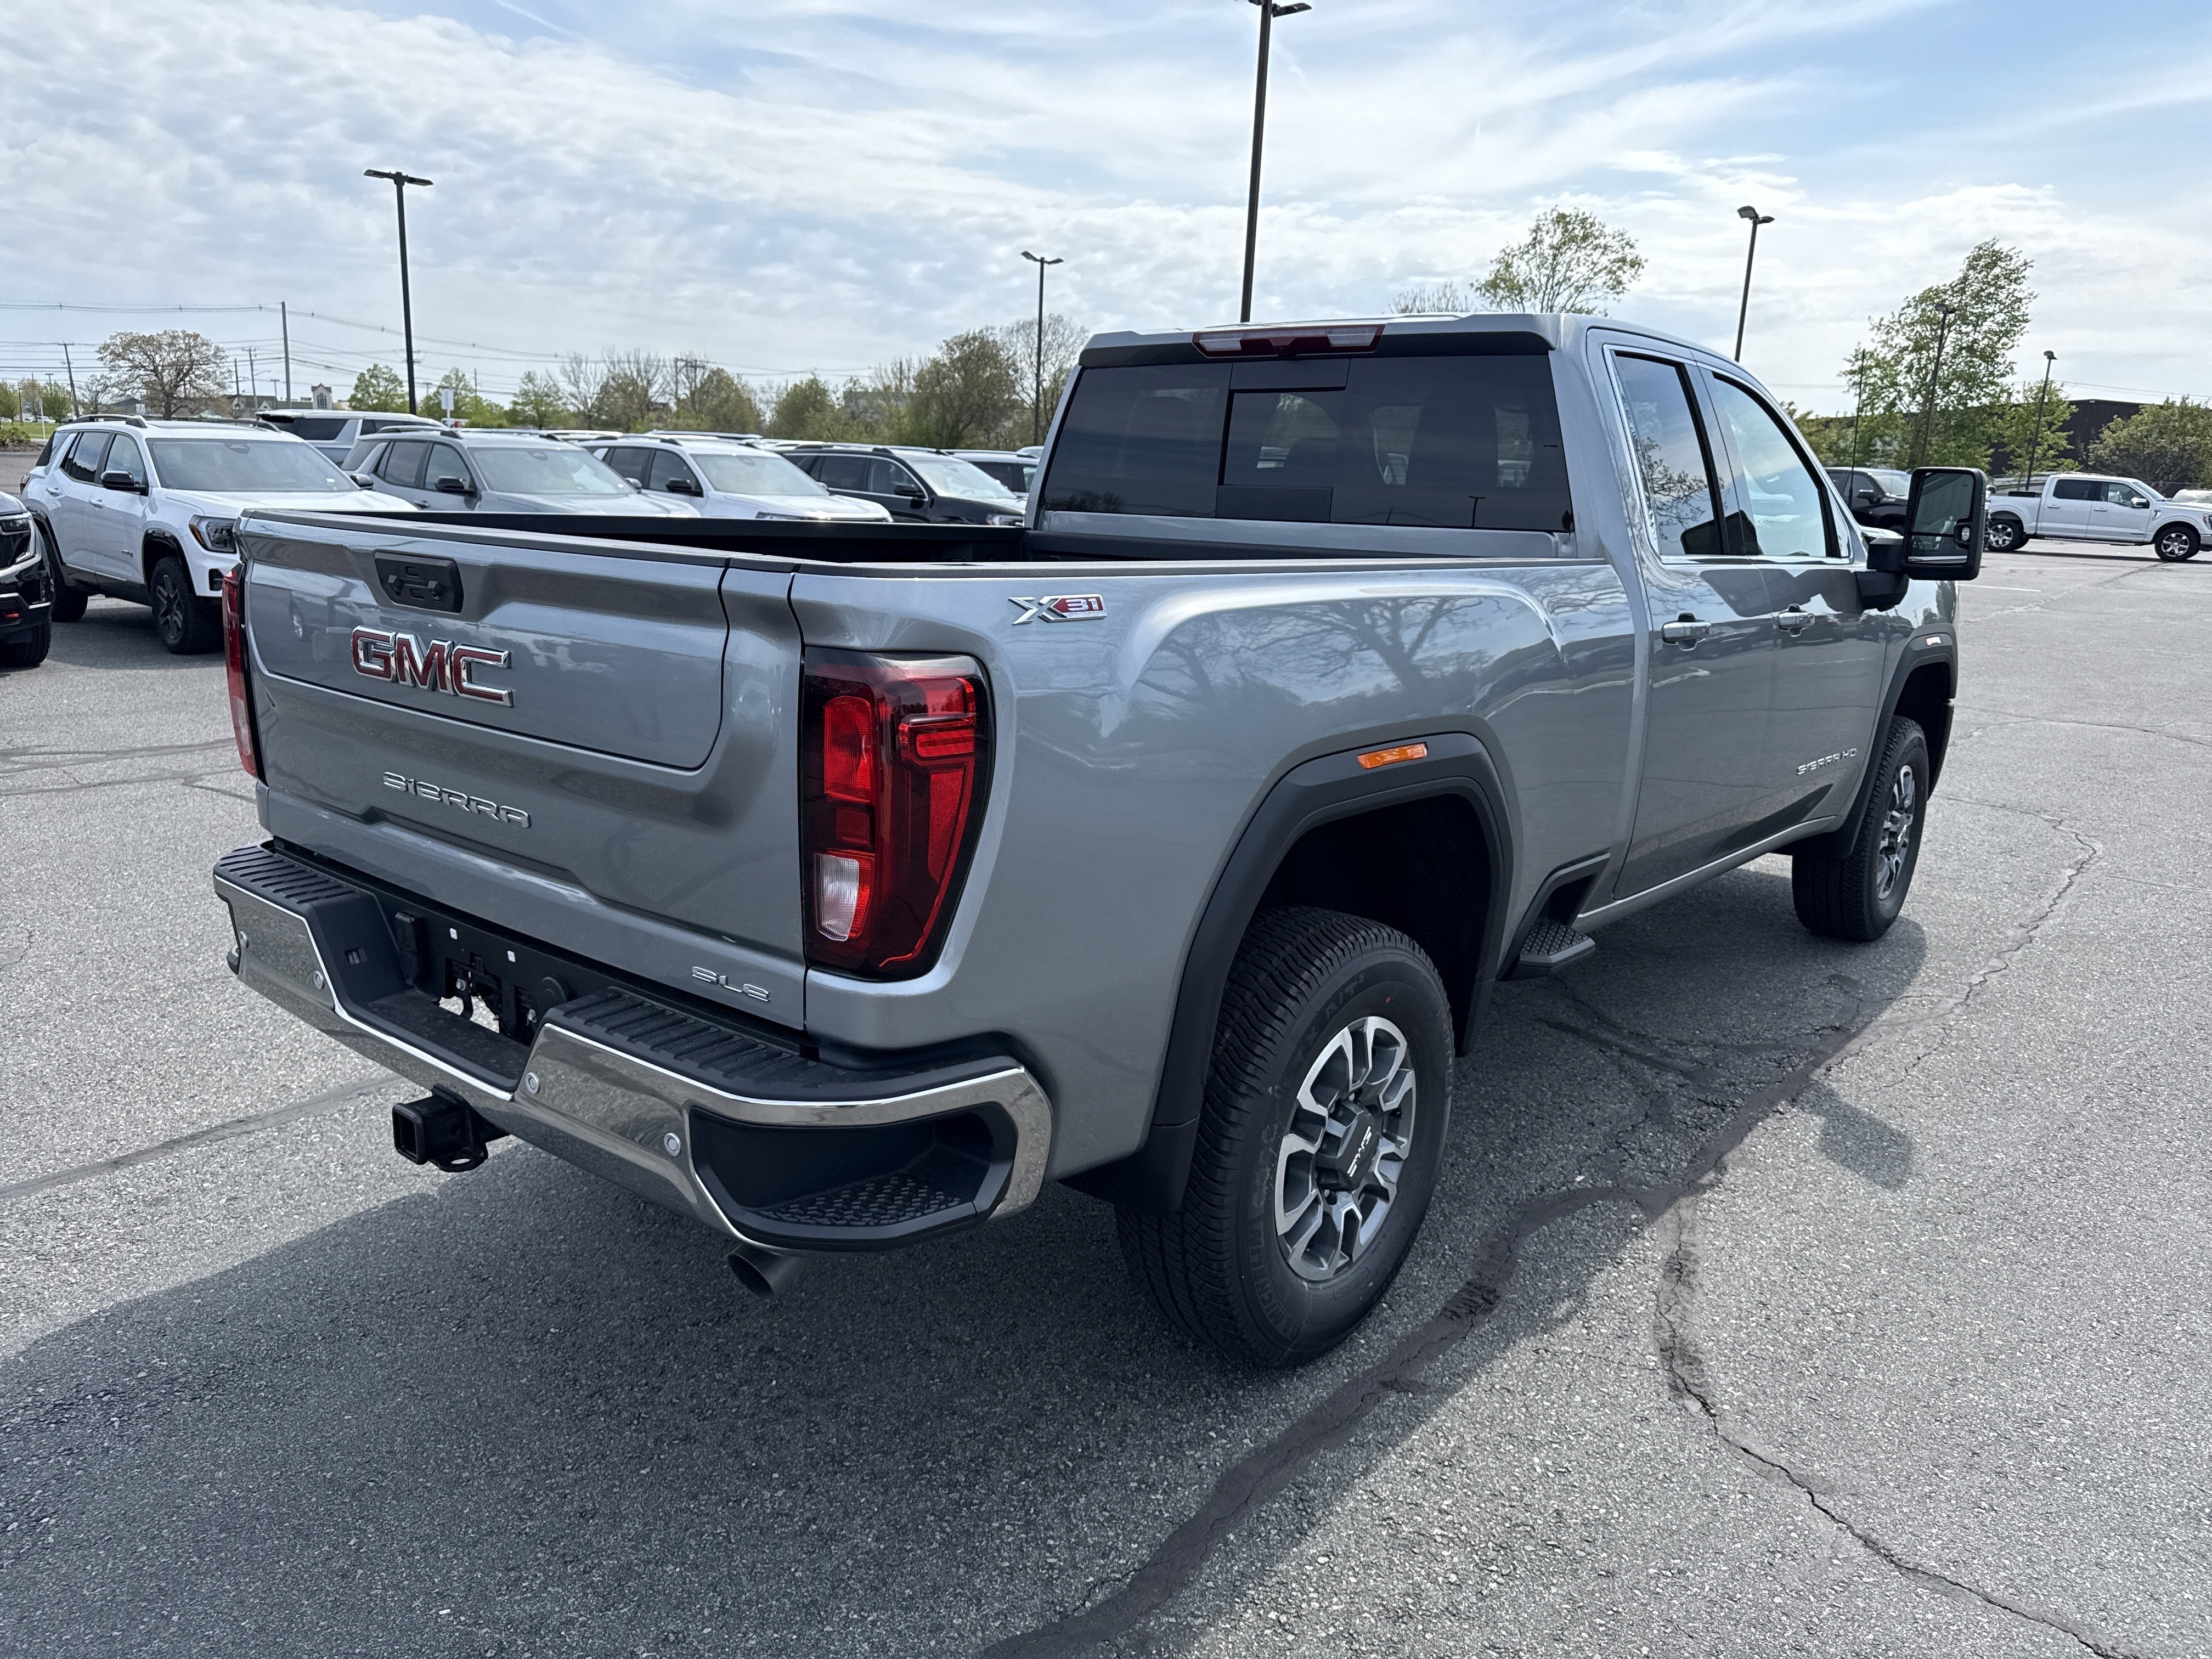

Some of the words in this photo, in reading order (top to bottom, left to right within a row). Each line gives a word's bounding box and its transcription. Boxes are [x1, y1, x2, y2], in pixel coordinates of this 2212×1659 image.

[1008, 594, 1104, 624] X31
[351, 625, 514, 708] GMC
[1796, 753, 1841, 776] SIERRA
[383, 771, 531, 828] SIERRA
[692, 966, 771, 1002] SLE
[1249, 1228, 1286, 1326] MICHELIN
